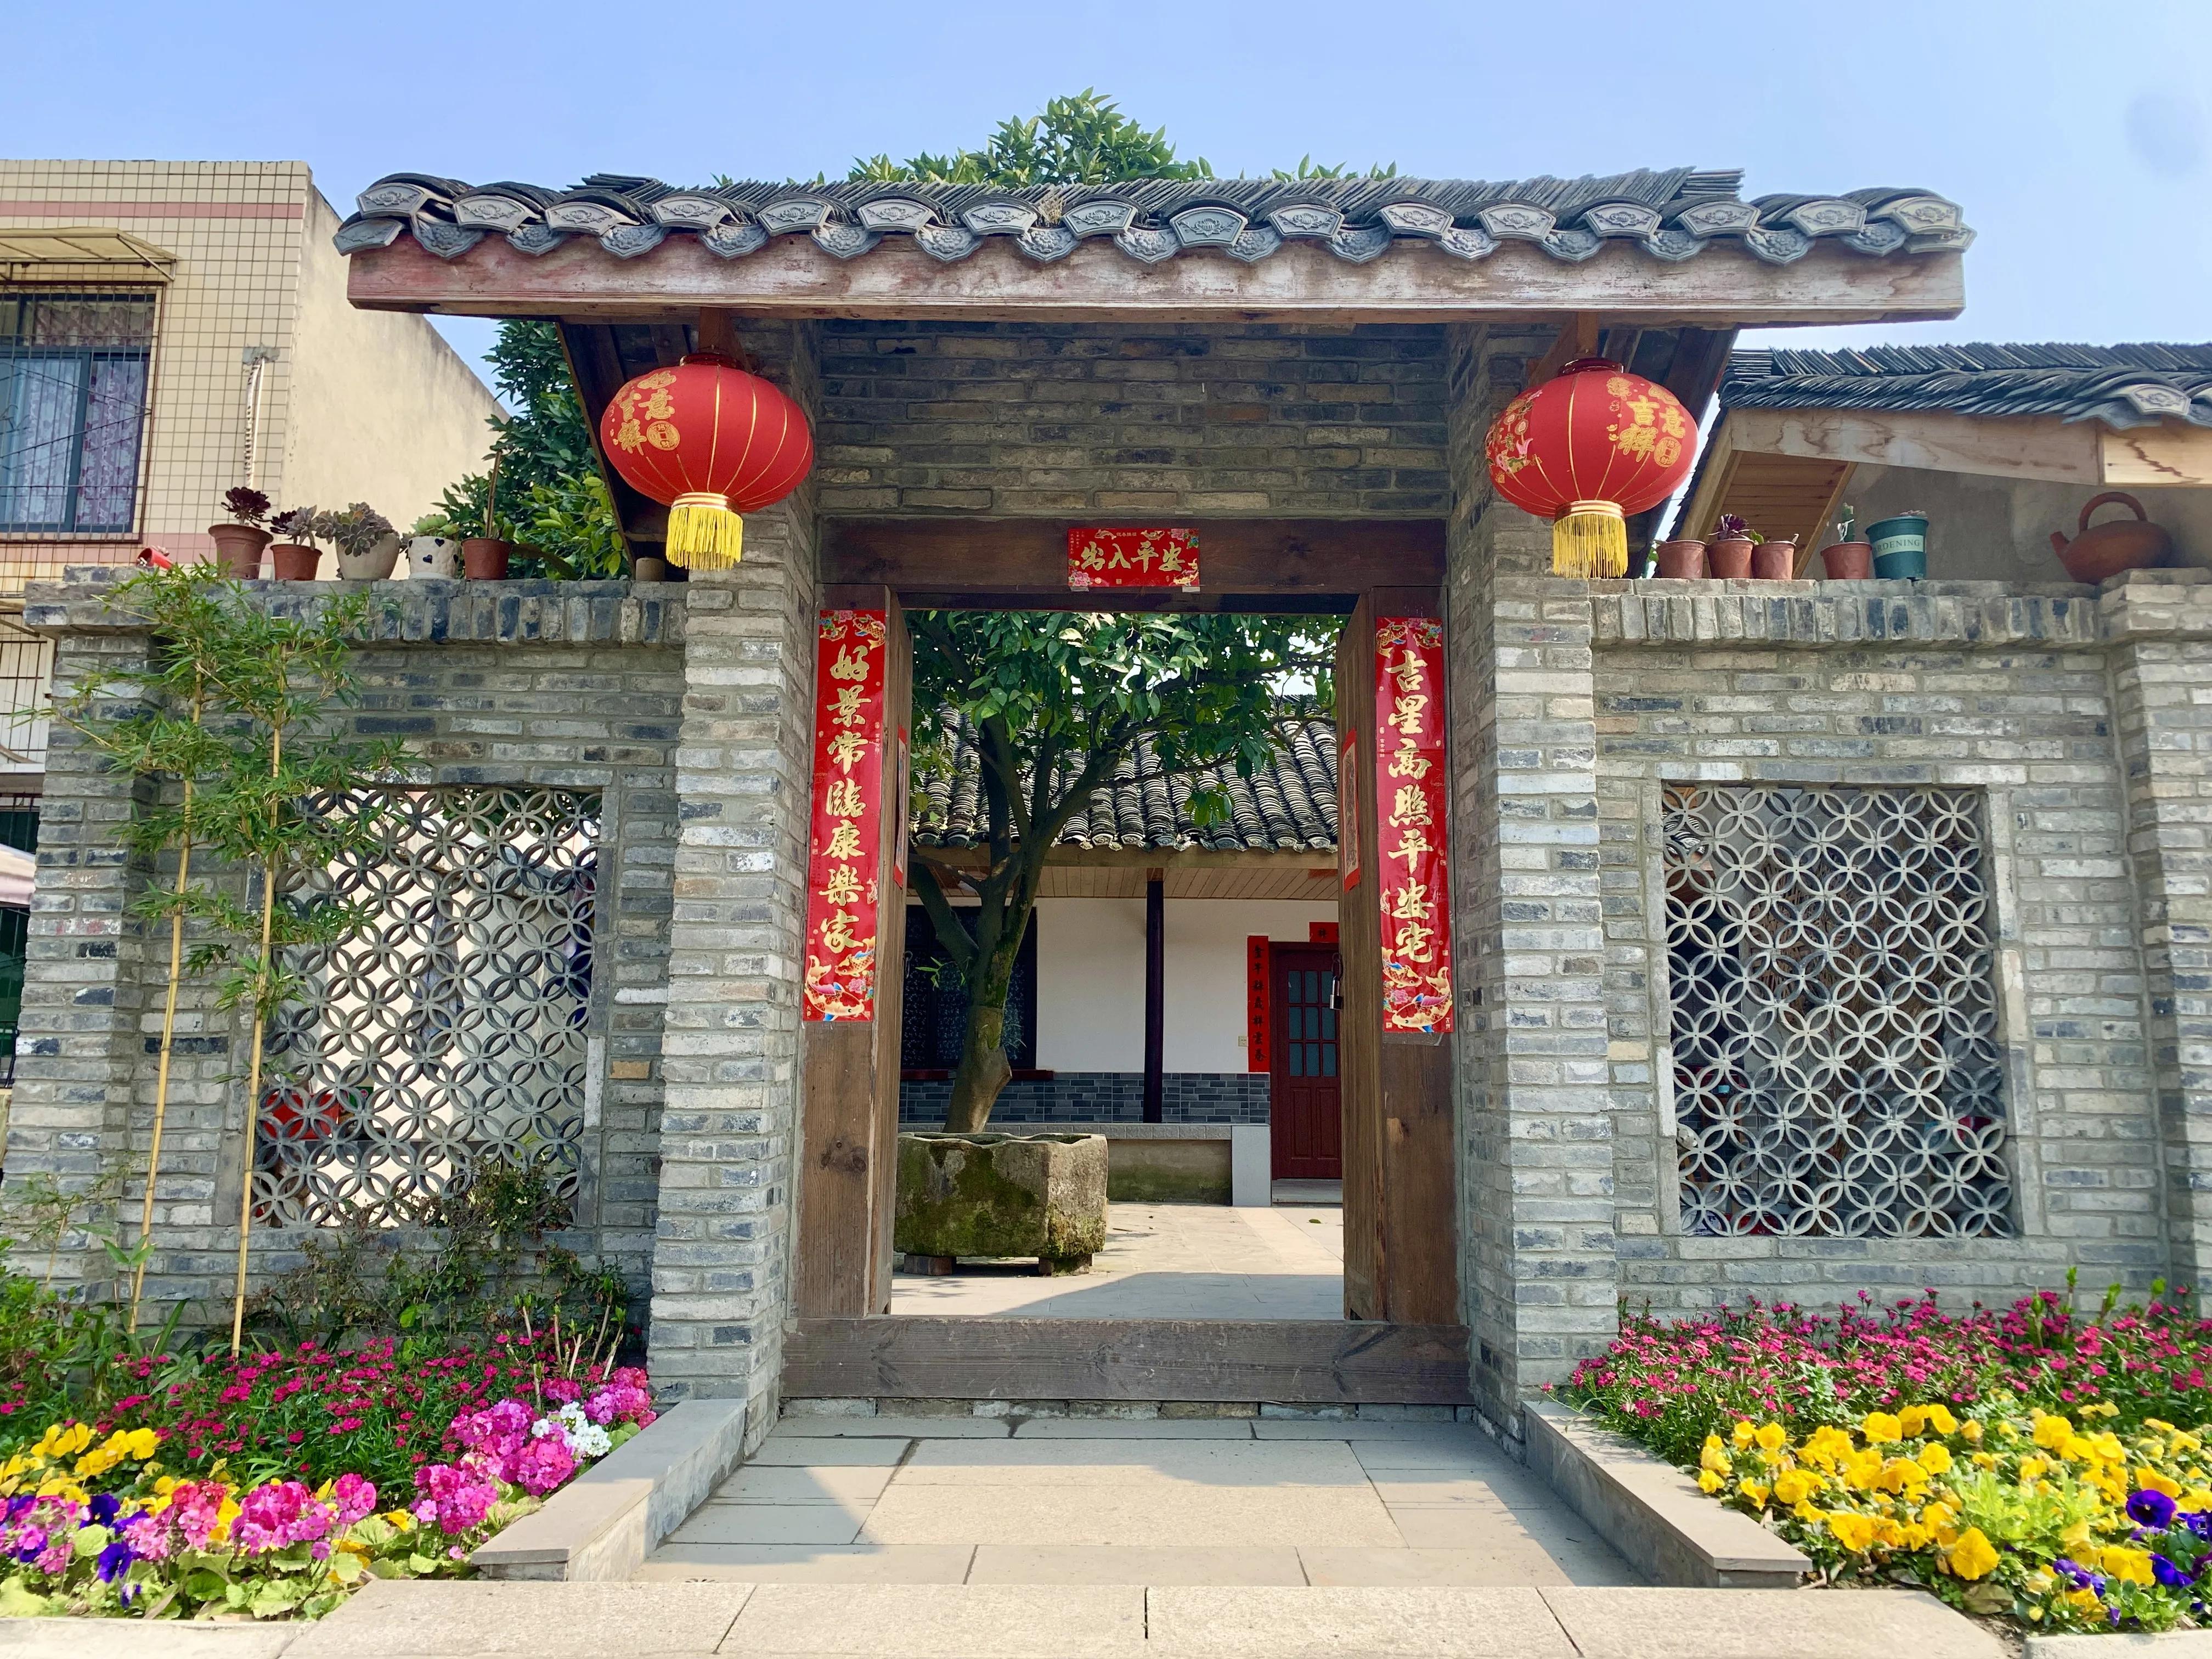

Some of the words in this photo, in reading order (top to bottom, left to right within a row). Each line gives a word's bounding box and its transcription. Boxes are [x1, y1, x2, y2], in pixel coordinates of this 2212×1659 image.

[618, 390, 647, 455] 吉祥
[637, 370, 677, 420] 如意
[1618, 394, 1660, 462] 吉祥
[1081, 540, 1186, 573] 出入平安
[1384, 649, 1435, 964] 吉星高照平安宅
